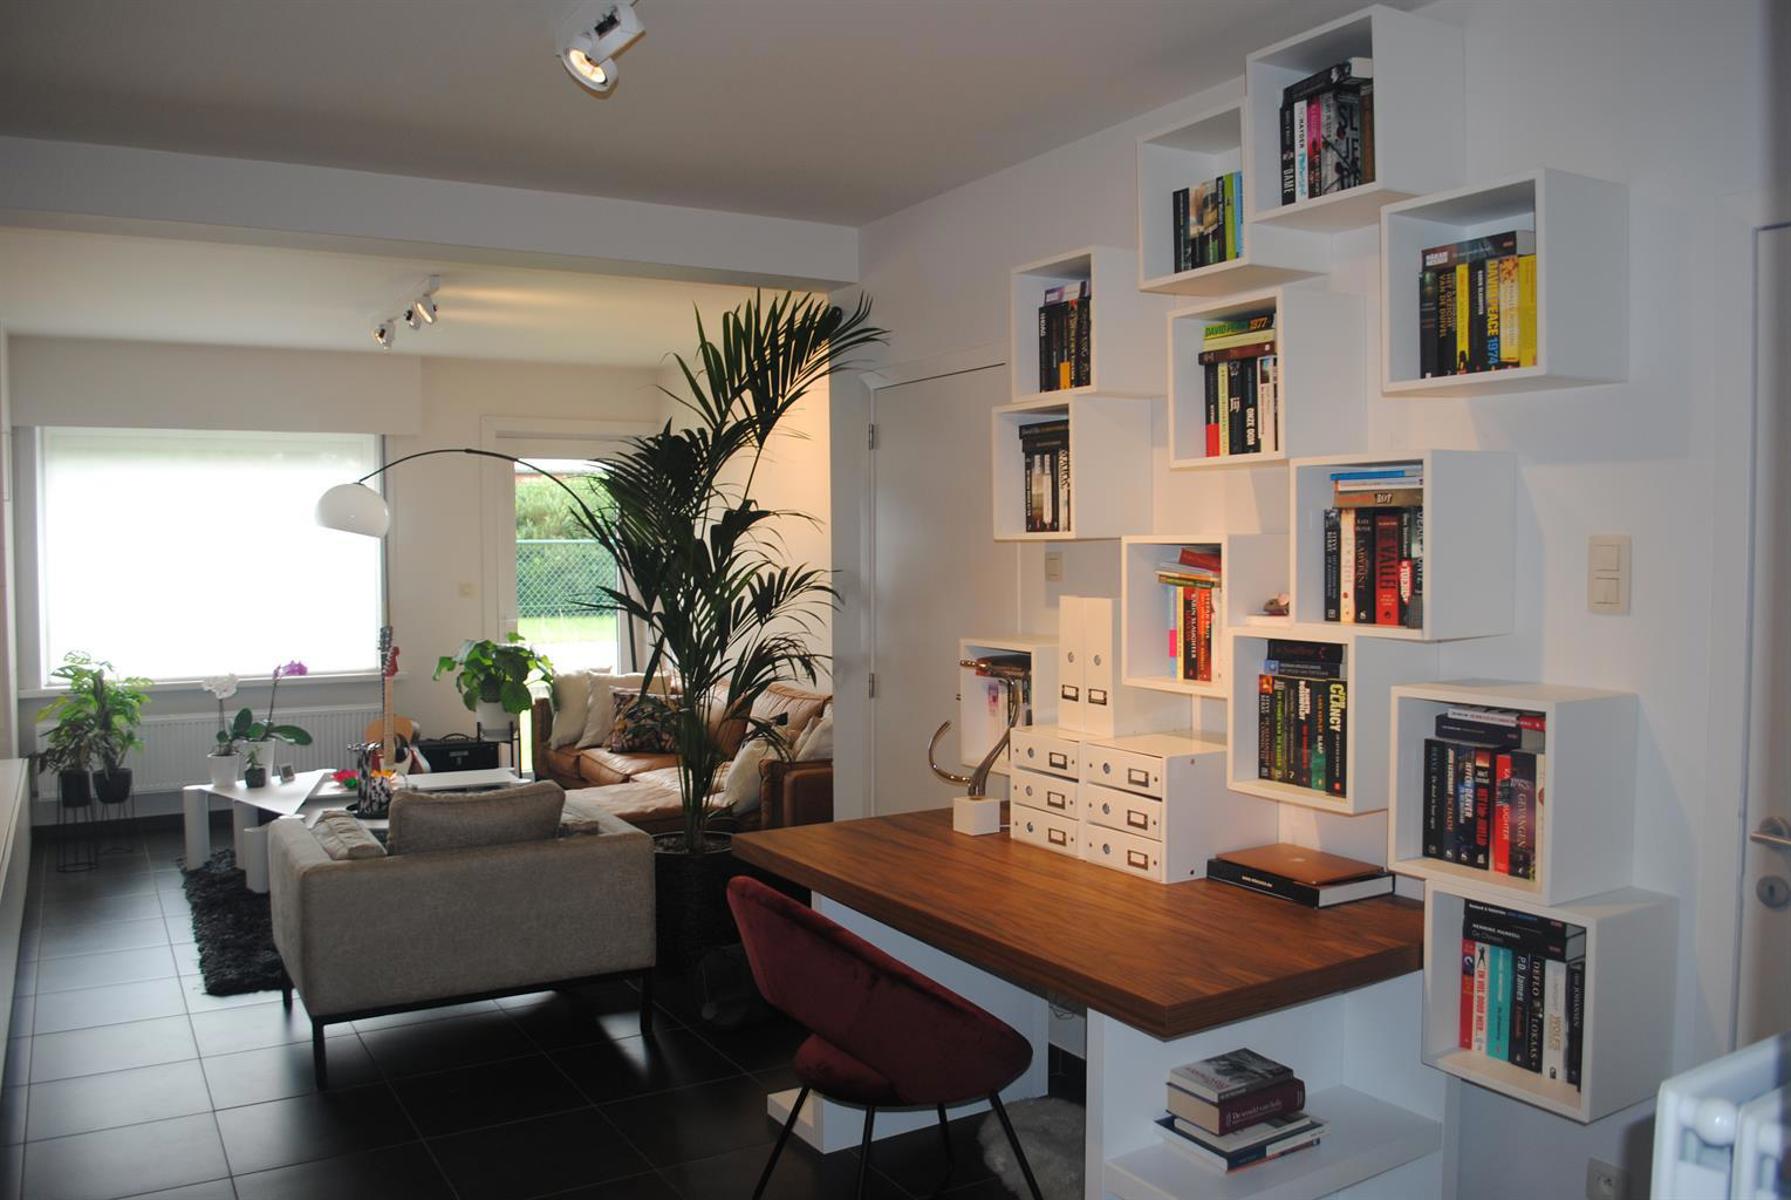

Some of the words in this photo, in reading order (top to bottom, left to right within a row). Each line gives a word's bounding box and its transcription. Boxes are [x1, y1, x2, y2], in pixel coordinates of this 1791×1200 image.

[1283, 168, 1294, 193] DAME
[1487, 337, 1499, 365] 1974
[1246, 407, 1255, 428] ONZE
[1378, 545, 1397, 589] VALLEI
[1329, 683, 1344, 732] CLANCY
[1464, 787, 1473, 818] DEAVER
[1516, 974, 1526, 1002] James
[1531, 960, 1541, 996] DEFLO
[1530, 1018, 1540, 1059] LOKAAS
